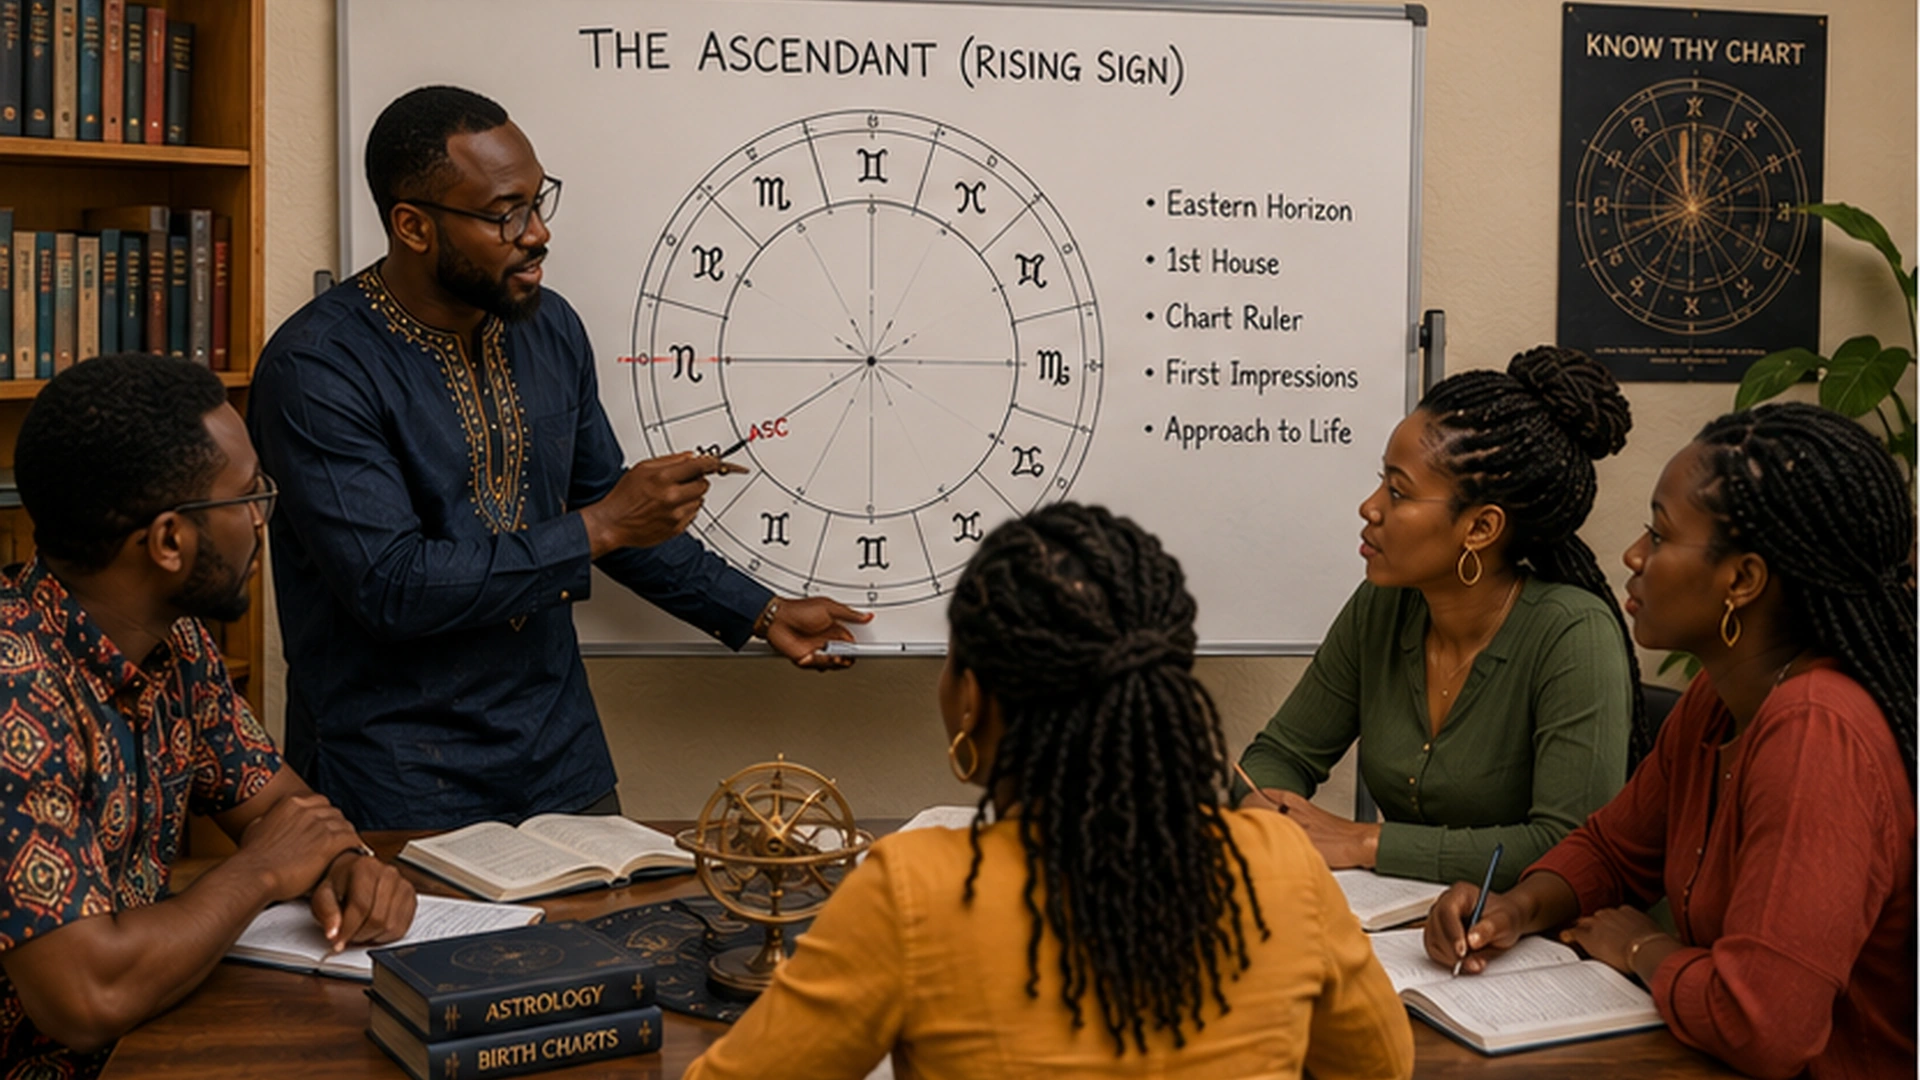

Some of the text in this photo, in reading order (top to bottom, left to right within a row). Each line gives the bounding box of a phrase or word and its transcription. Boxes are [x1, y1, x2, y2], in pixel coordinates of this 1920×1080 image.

[579, 28, 1185, 96] THE ASCENDANT (RISING SIGN)
[1586, 33, 1805, 66] KNOW THY CHART
[1167, 189, 1352, 221] Eastern Horizon
[1167, 246, 1279, 275] 1st House
[1166, 303, 1302, 331] Chart Ruler
[1166, 358, 1358, 395] First Impressions
[747, 417, 788, 441] ASC
[1164, 415, 1352, 450] Approach to Life
[485, 985, 604, 1022] ASTROLOGY
[478, 1028, 619, 1070] BIRTH CHARTS
